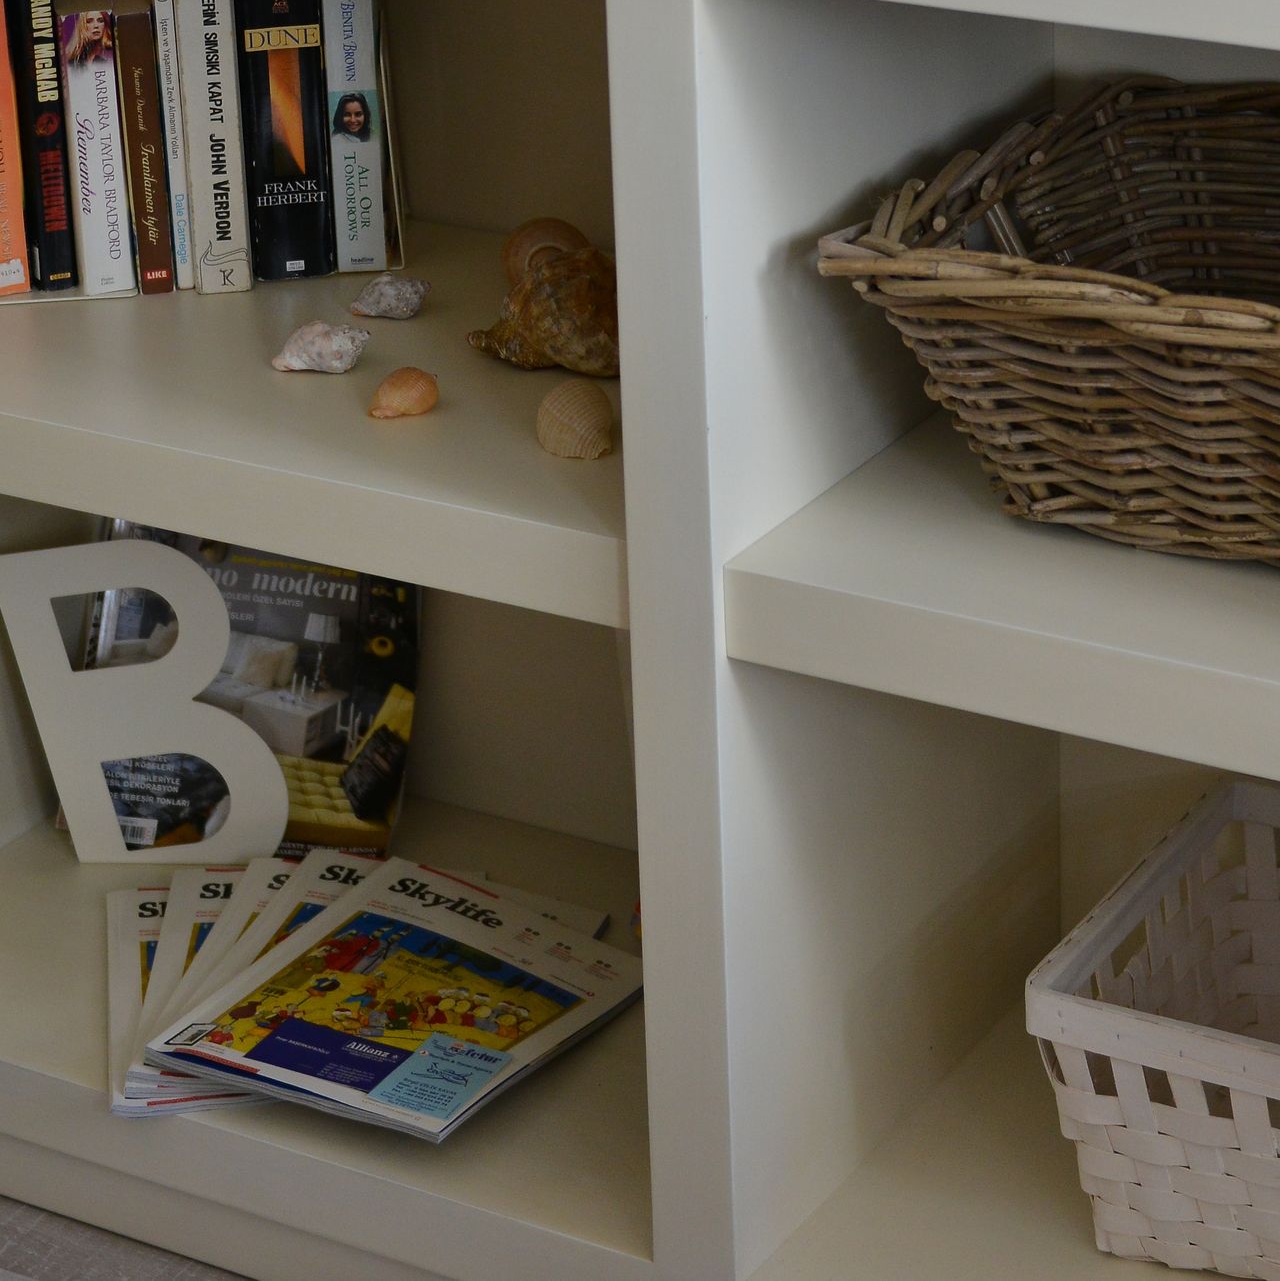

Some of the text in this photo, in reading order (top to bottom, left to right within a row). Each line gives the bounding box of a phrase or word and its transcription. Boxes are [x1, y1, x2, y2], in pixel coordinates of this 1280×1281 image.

[203, 32, 222, 76] SIMSIKI
[248, 25, 319, 49] DUNE
[340, 0, 358, 82] BENITA BROWN
[94, 70, 111, 131] BARBARA
[166, 86, 176, 101] Zevk
[207, 81, 225, 124] KAPAT
[76, 113, 97, 215] Remember
[100, 133, 116, 185] TAYLOR
[209, 132, 227, 176] JOHN
[39, 149, 69, 233] MELTDOWN
[257, 191, 327, 207] HERBERT
[264, 180, 318, 194] FRANK
[343, 152, 360, 242] TOMORROWS
[358, 165, 373, 229] ALL OUR
[104, 189, 122, 261] BRADFORD
[175, 194, 188, 265] Dale Carnegie
[212, 181, 232, 242] VERDON
[147, 270, 167, 279] LIKE
[207, 568, 238, 587] no
[251, 572, 358, 602] modern
[106, 770, 128, 779] ALON
[123, 780, 179, 793] DEKORASYON
[387, 877, 504, 929] Skylife
[346, 1040, 390, 1057] Allianz
